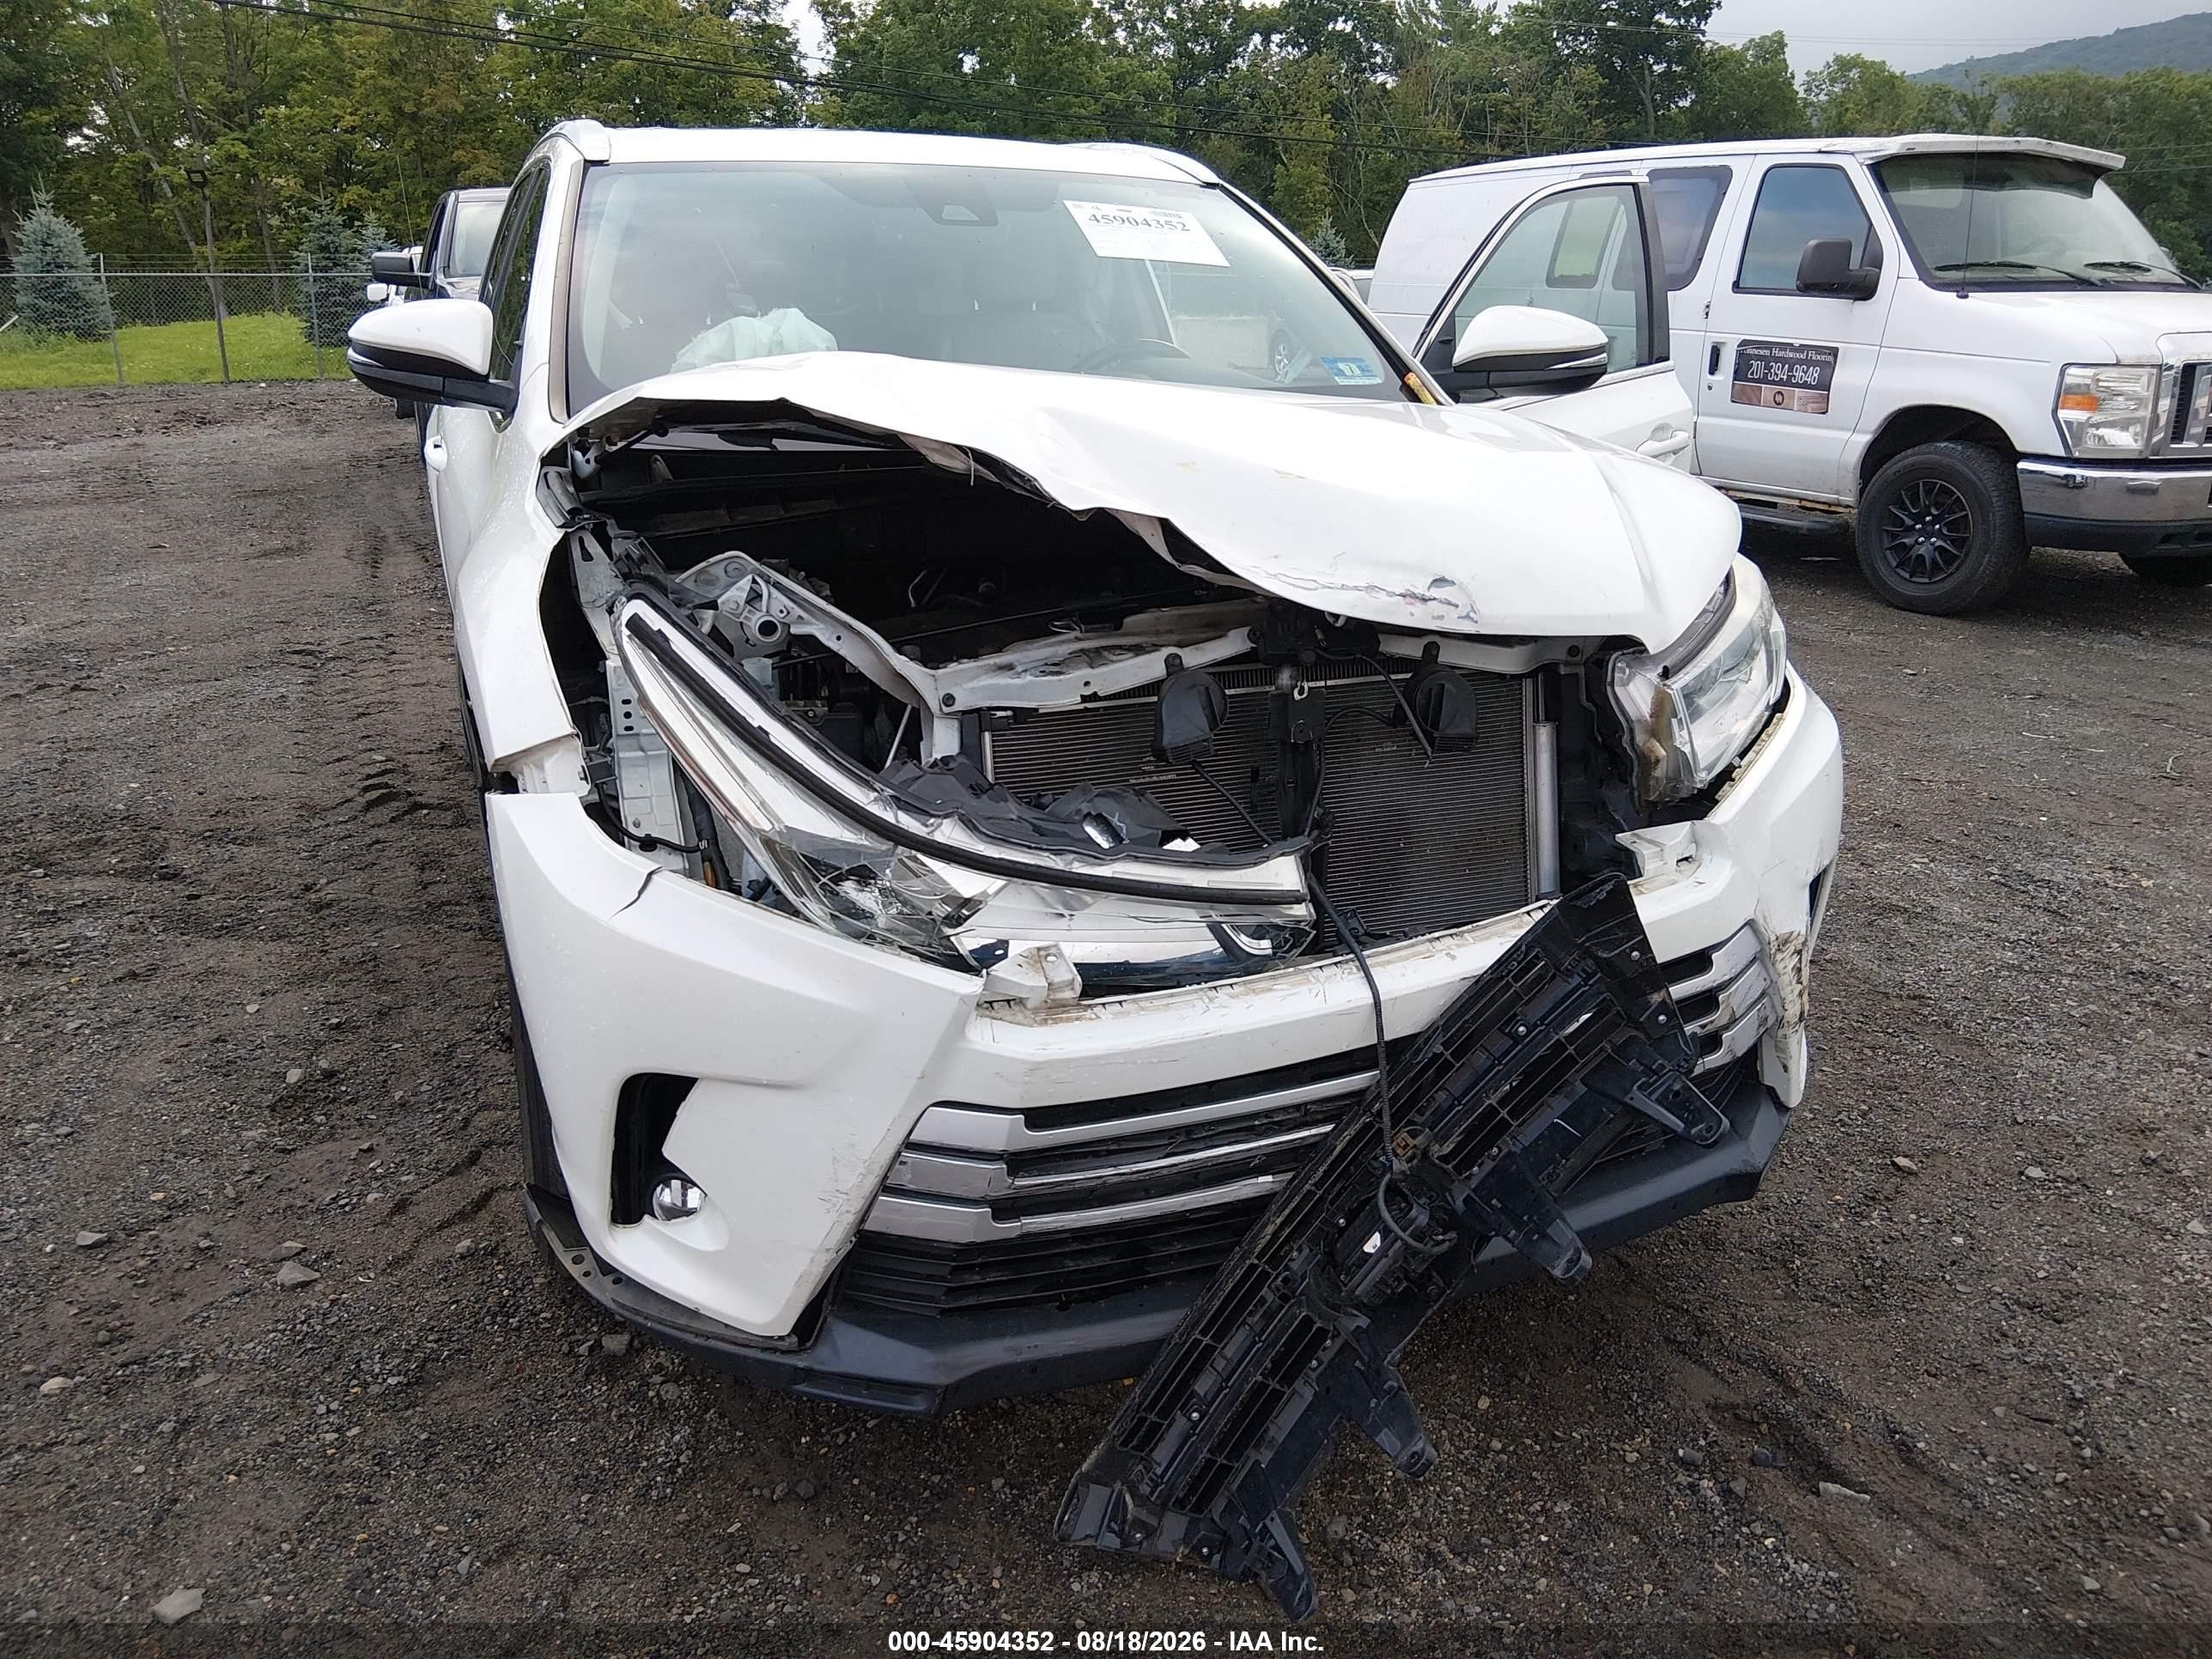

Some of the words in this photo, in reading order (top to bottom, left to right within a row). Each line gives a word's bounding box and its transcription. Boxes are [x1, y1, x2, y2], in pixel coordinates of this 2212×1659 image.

[1088, 213, 1191, 232] 45904352
[1740, 348, 1771, 356] onnesen
[1771, 347, 1808, 360] Hardwood
[1747, 360, 1820, 386] 201-394-9648
